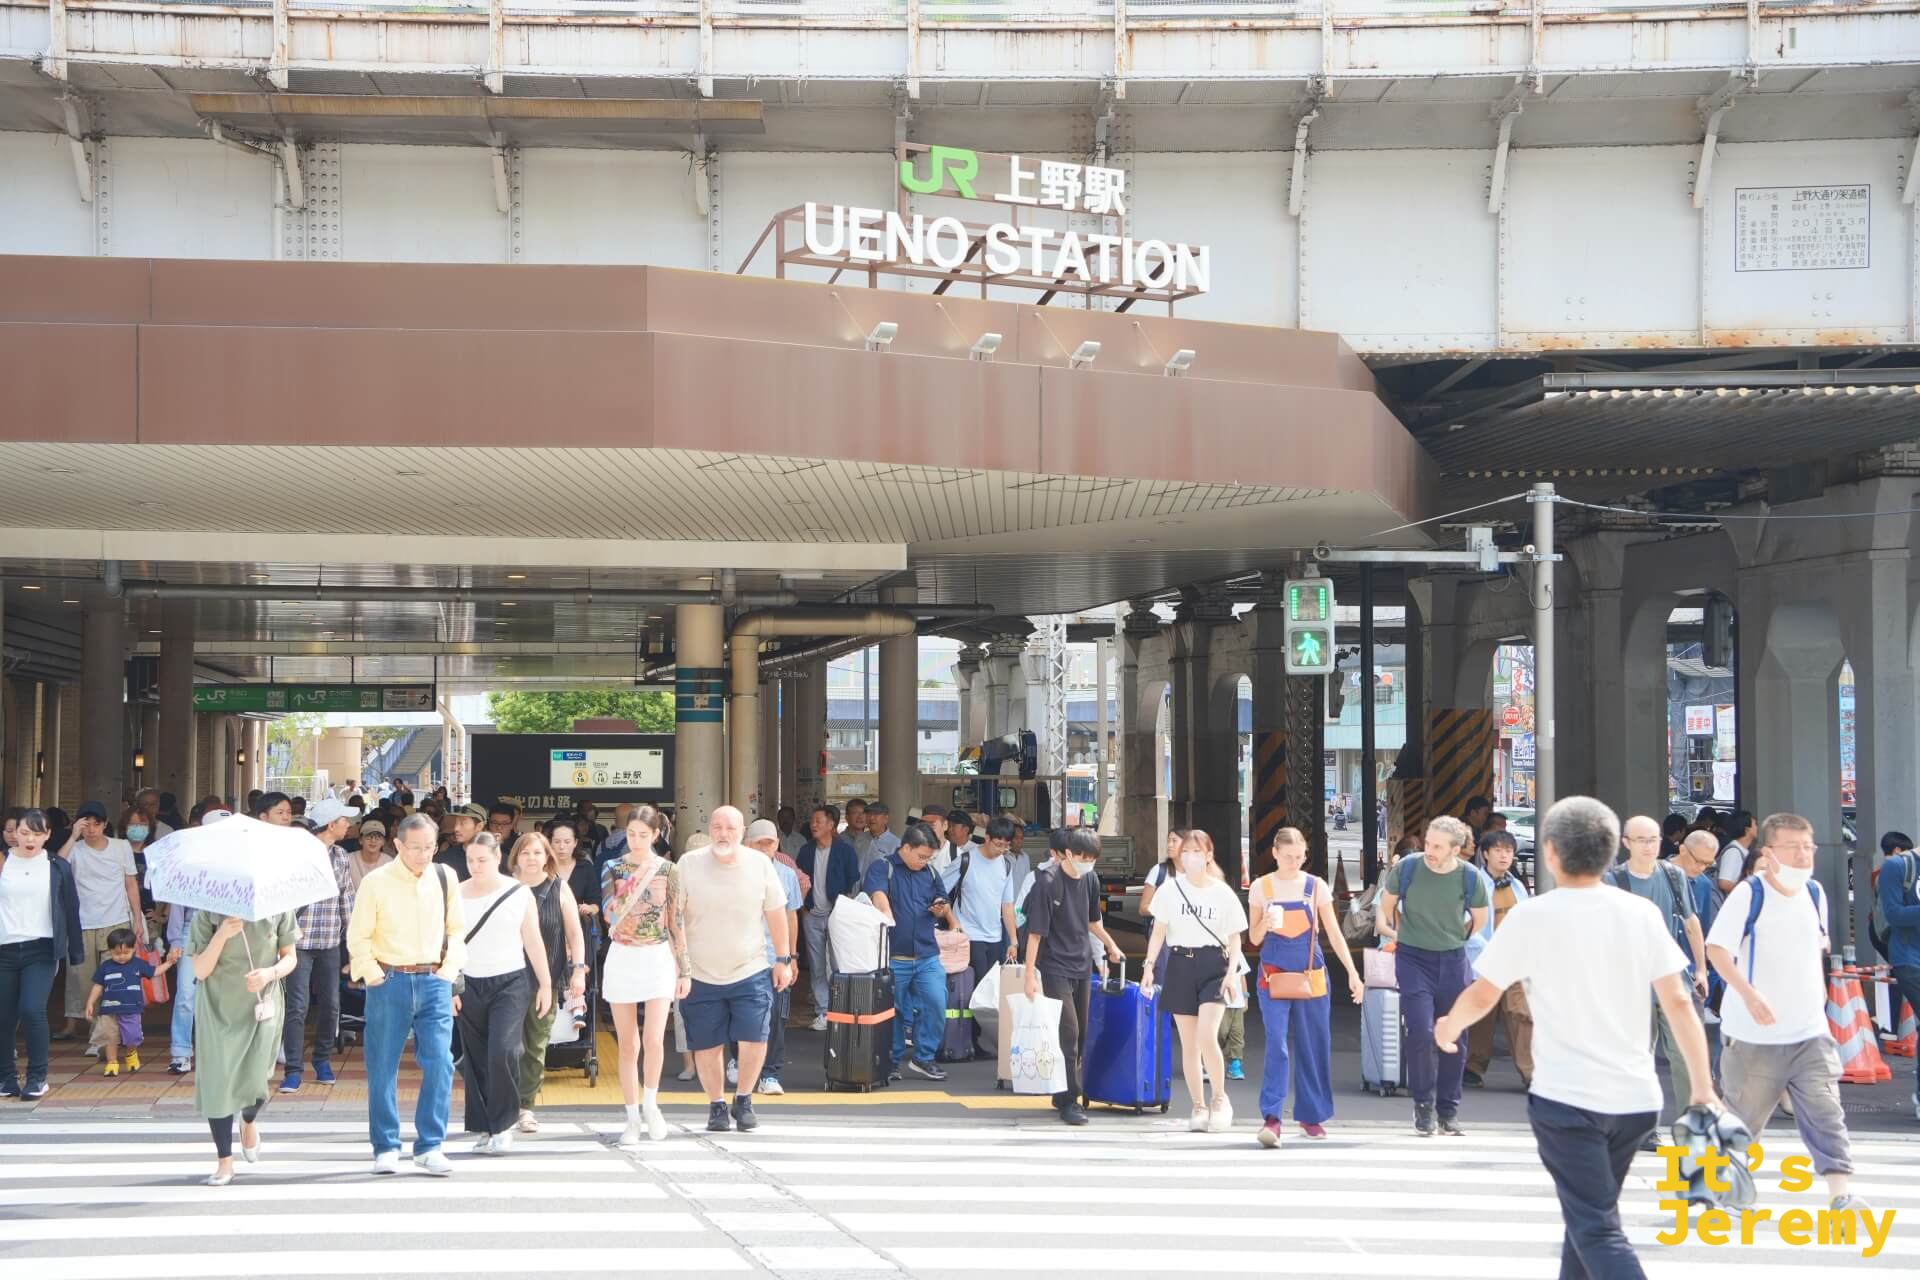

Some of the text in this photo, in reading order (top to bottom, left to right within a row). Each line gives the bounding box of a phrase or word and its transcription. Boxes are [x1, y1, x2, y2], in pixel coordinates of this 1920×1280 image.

[900, 144, 1126, 215] JR 上野駅
[804, 202, 1210, 293] UENO STATION
[612, 770, 642, 779] 上野駅
